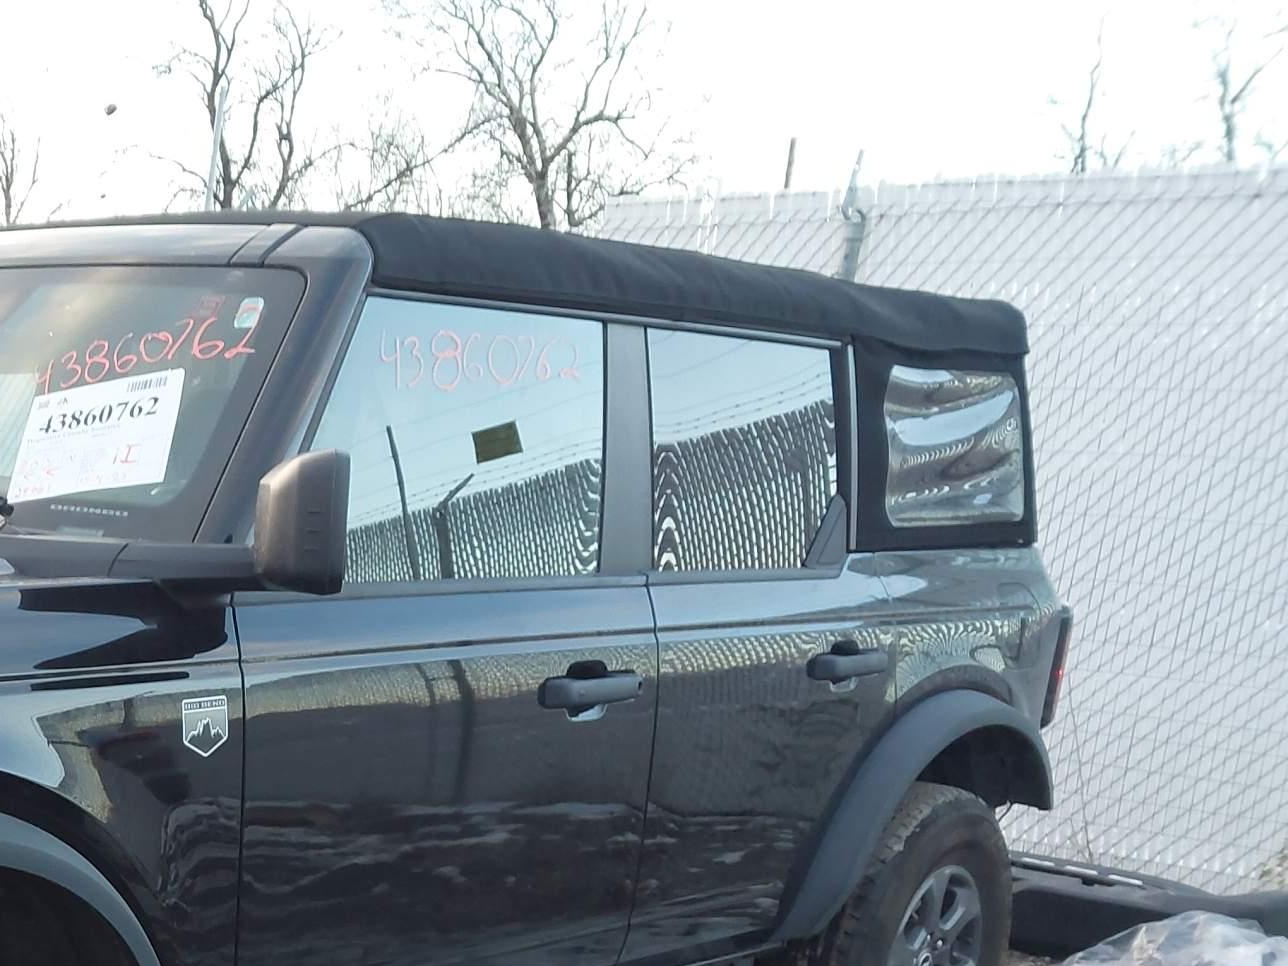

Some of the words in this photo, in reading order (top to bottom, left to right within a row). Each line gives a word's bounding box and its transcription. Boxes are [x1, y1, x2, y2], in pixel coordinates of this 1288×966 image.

[34, 302, 260, 394] 43860762
[380, 329, 581, 392] 43860762
[39, 396, 160, 434] 43860762
